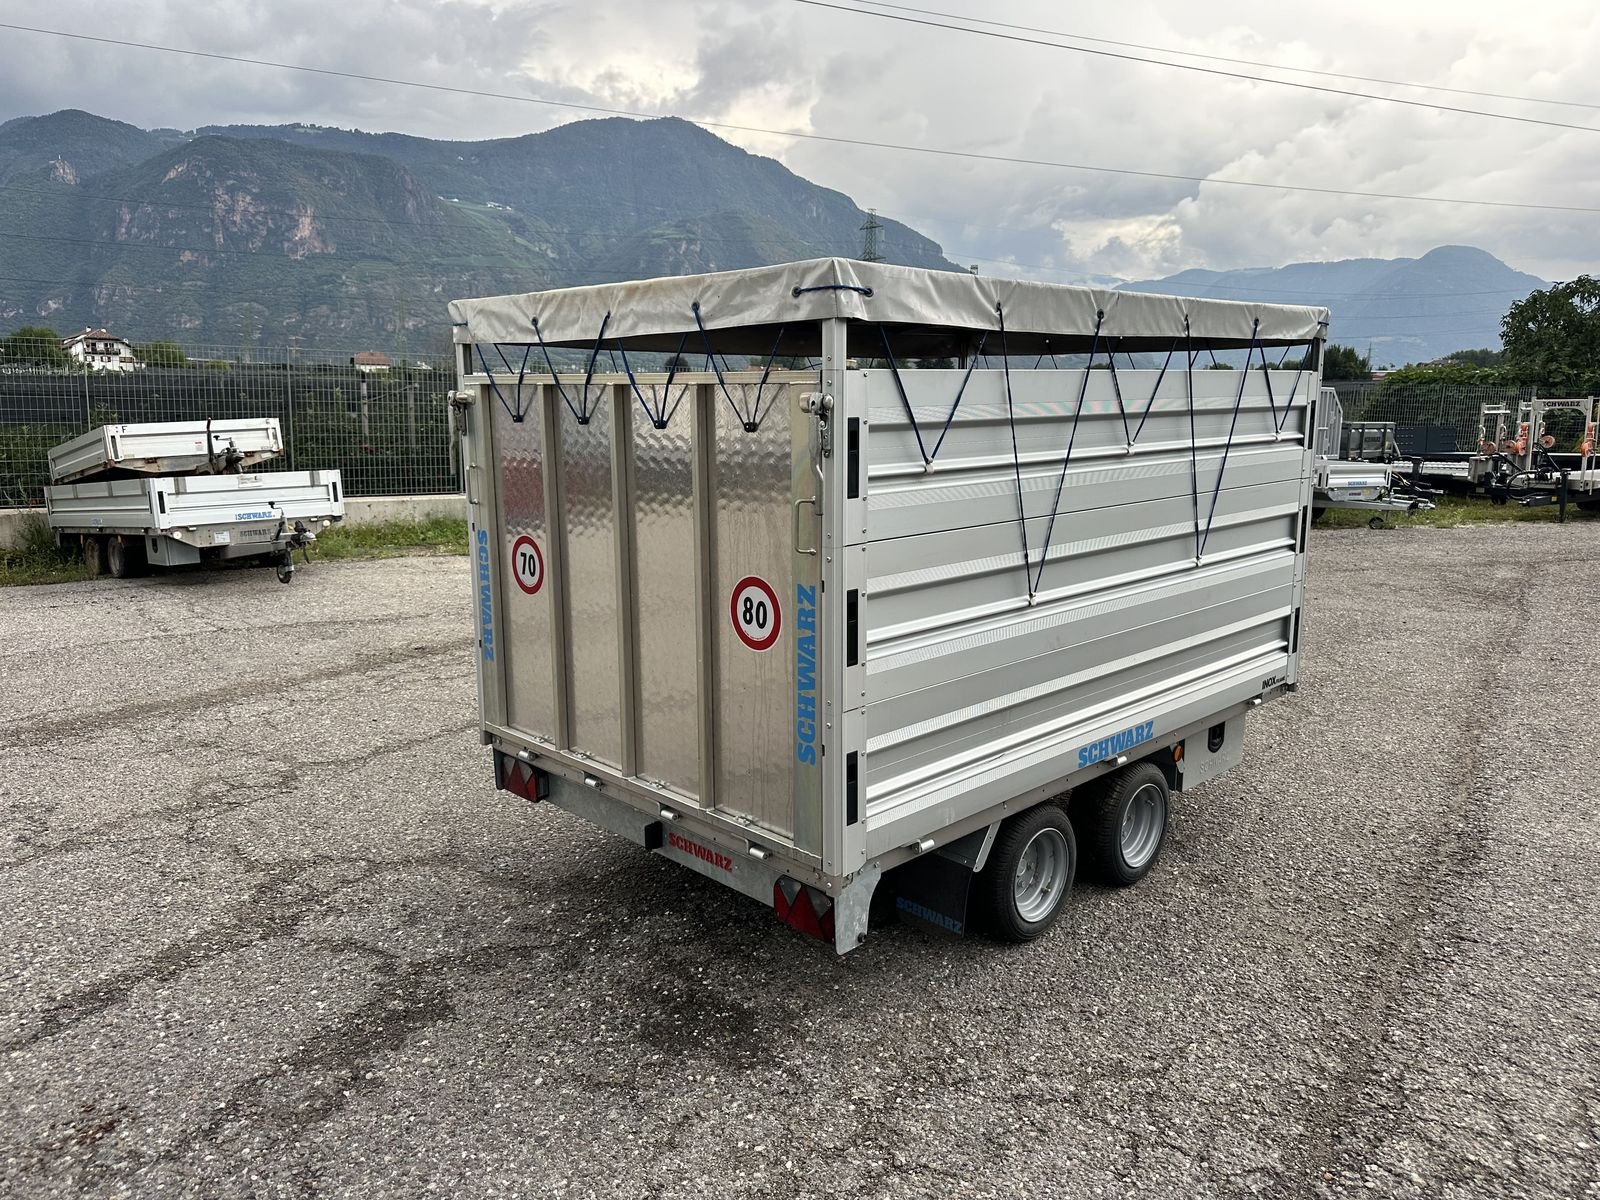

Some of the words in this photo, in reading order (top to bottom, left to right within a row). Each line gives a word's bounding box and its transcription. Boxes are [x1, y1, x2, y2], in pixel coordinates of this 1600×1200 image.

[237, 511, 273, 520] SCHWARZ
[520, 551, 536, 577] 70
[477, 529, 495, 662] SCHWARZ
[743, 596, 768, 630] 80
[796, 583, 816, 766] SCHWARZ
[1078, 719, 1154, 768] SCHWARZ
[668, 832, 733, 873] SCHWARZ
[896, 896, 962, 935] SCHWARZ
